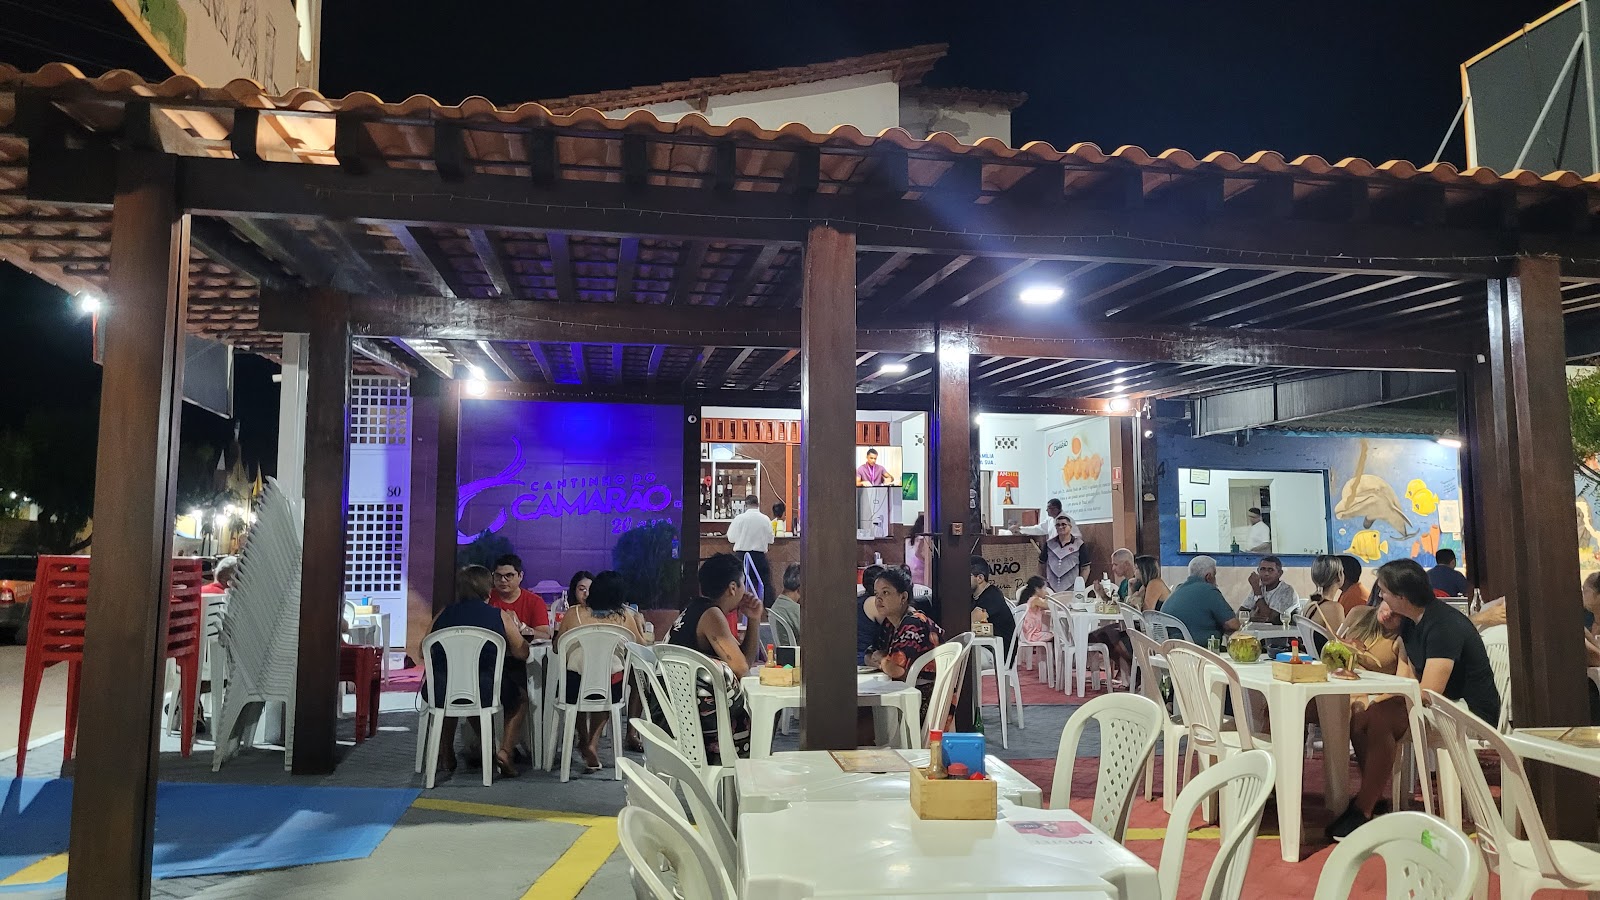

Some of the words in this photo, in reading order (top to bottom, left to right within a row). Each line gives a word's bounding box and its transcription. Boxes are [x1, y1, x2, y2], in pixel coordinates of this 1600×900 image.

[530, 474, 626, 492] CANTINHO
[632, 472, 656, 484] DO
[387, 486, 401, 497] 80
[511, 484, 672, 521] CAMARÃO
[988, 562, 1020, 575] ARÃO
